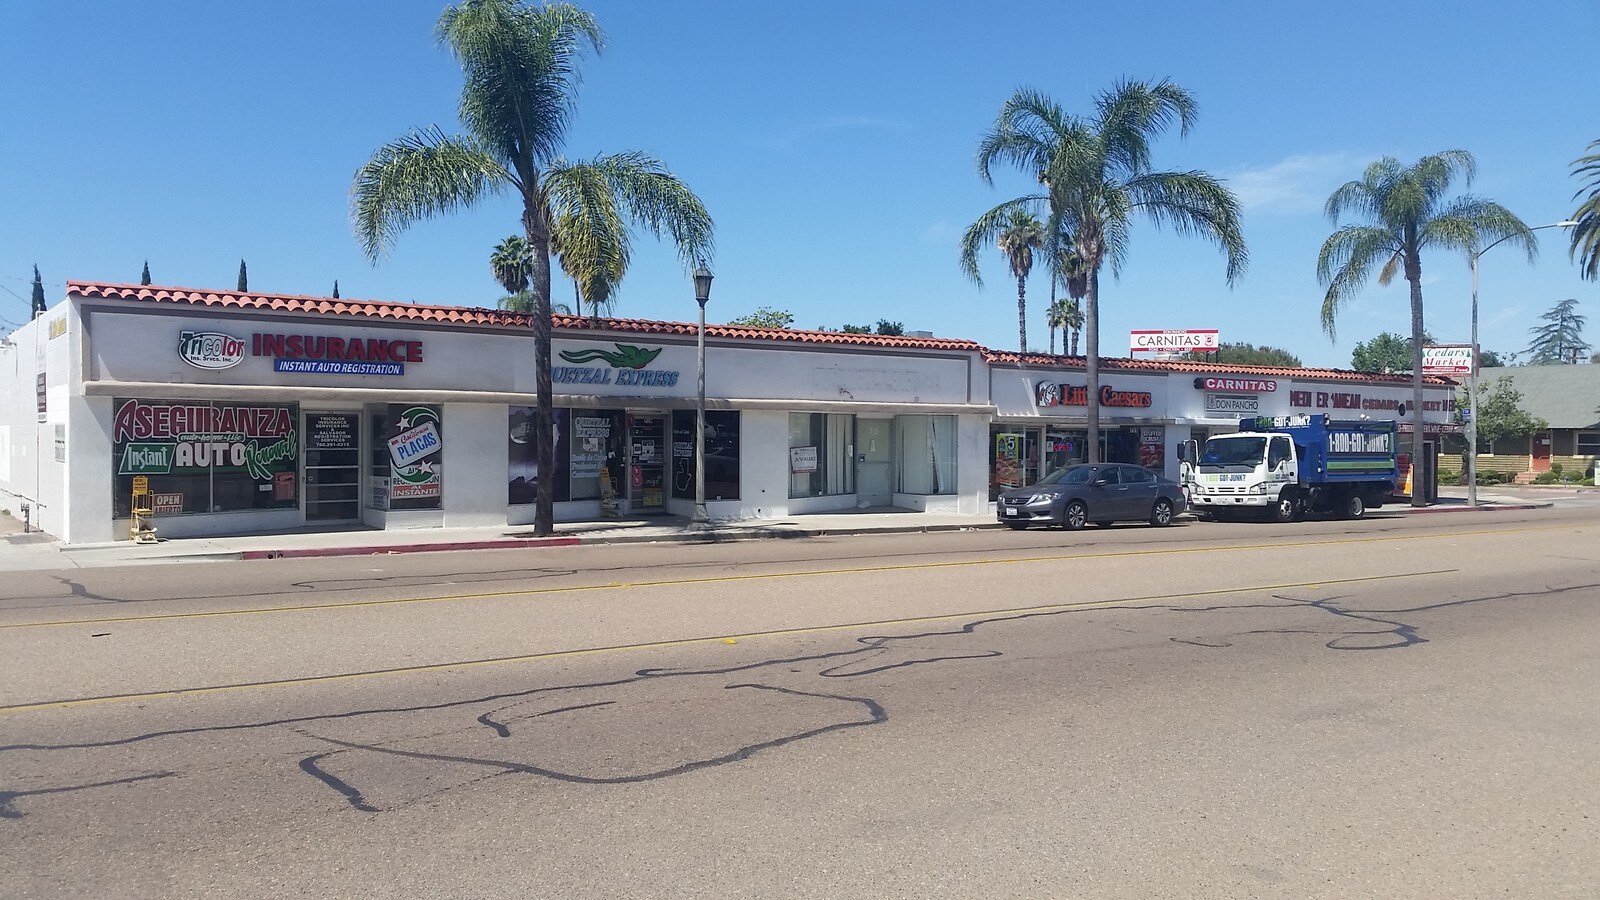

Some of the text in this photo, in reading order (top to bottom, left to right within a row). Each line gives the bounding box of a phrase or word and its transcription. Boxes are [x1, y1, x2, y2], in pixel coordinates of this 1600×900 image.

[181, 331, 245, 356] Tricolor
[252, 333, 423, 362] INSURANCE
[1137, 335, 1201, 346] CARNITAS
[1427, 348, 1466, 356] Cedars
[279, 361, 400, 375] INSTANT AUTO REGISTRATION
[1424, 358, 1467, 366] Market
[551, 366, 680, 387] UETZAL EXPRESS
[1206, 379, 1276, 391] CARNITAS
[1062, 384, 1151, 407] Litt Caesars
[1216, 400, 1259, 410] DON PANCHO
[114, 399, 293, 443] ASEGURANZA
[397, 432, 438, 460] PLACAS
[1328, 432, 1389, 453] 1-800-GOT-JUNK?
[127, 442, 247, 471] Instant AUTO
[157, 495, 180, 505] OPEN
[394, 489, 438, 497] INSTANTE
